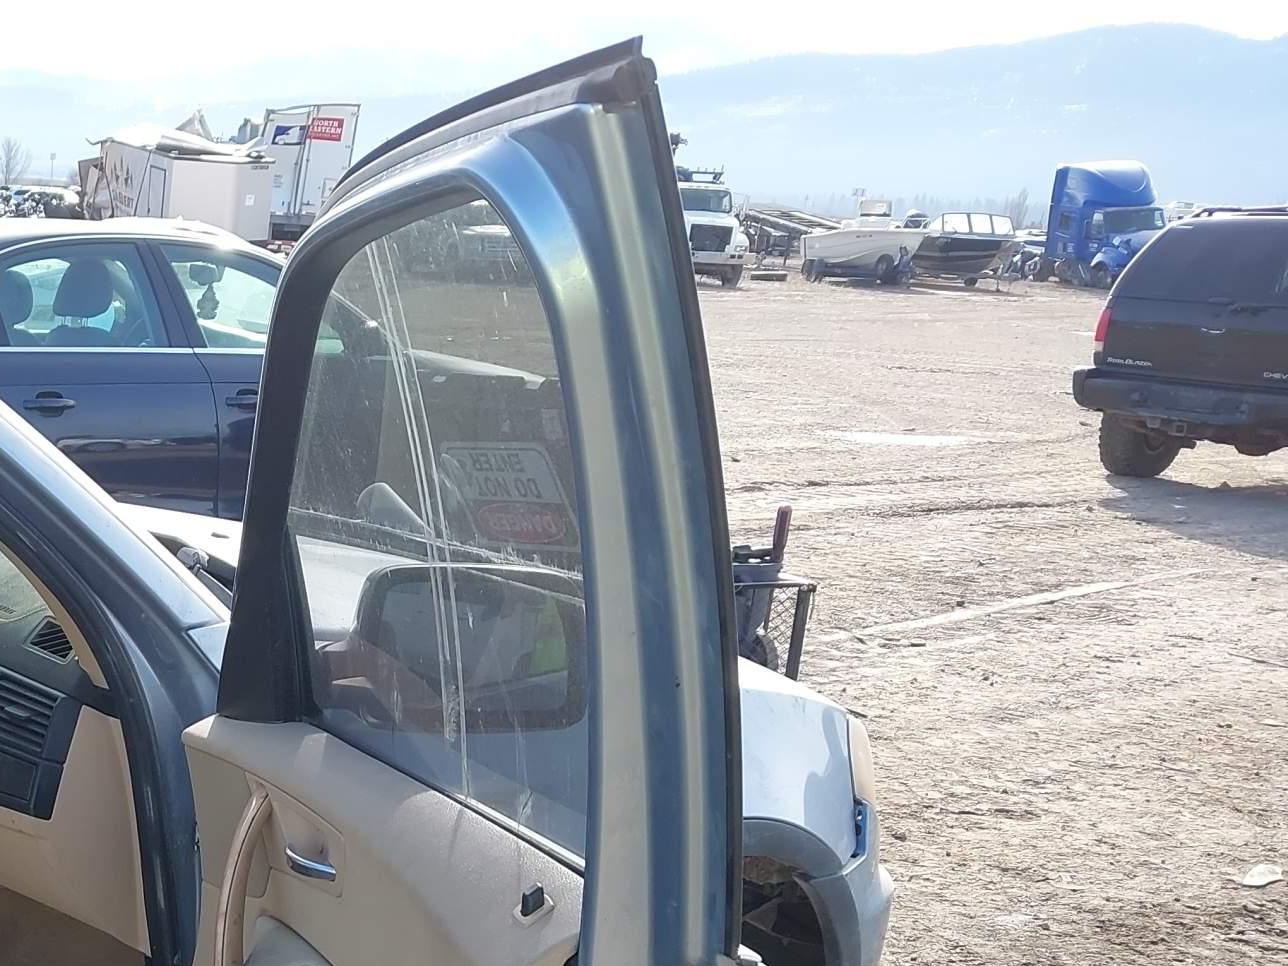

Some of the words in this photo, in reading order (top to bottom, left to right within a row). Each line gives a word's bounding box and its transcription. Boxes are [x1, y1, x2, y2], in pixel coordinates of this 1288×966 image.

[468, 452, 526, 473] ENTER
[476, 476, 512, 498] NOT
[513, 477, 542, 498] DO
